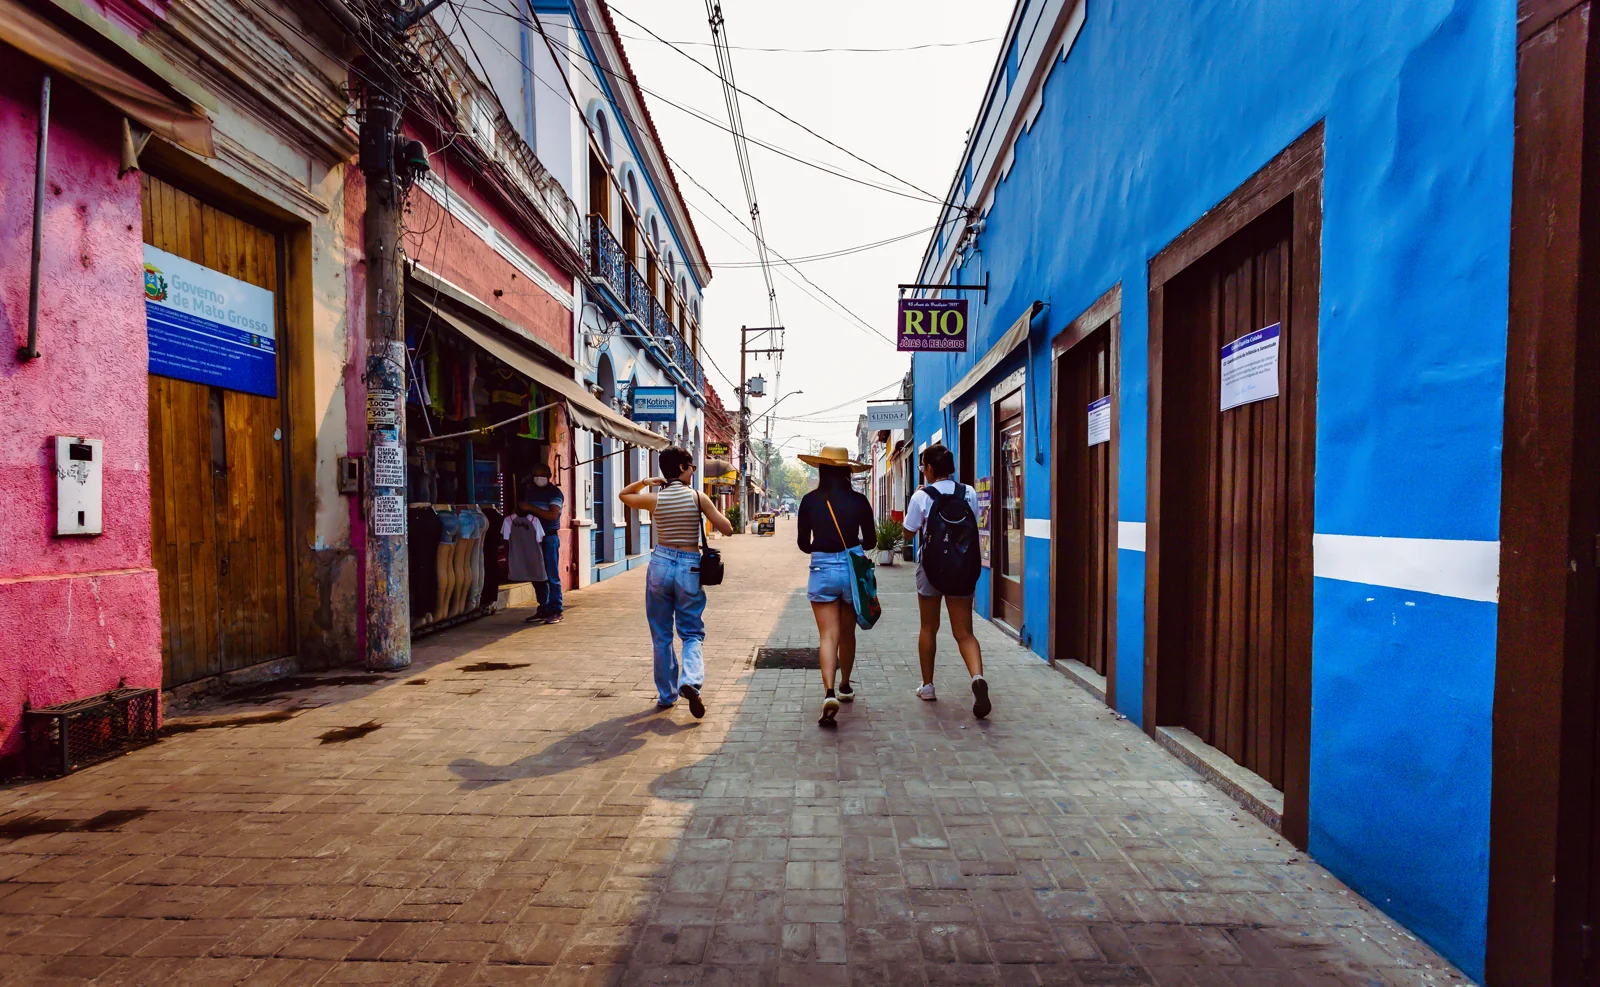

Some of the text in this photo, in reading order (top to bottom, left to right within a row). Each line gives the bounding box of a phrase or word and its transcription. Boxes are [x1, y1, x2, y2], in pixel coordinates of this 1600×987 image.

[172, 274, 225, 305] Governo
[173, 293, 188, 309] de
[193, 298, 225, 320] Mato
[228, 310, 268, 332] Grosso
[902, 310, 964, 336] RIO
[922, 339, 928, 348] &
[929, 338, 964, 348] RELÓGIOS
